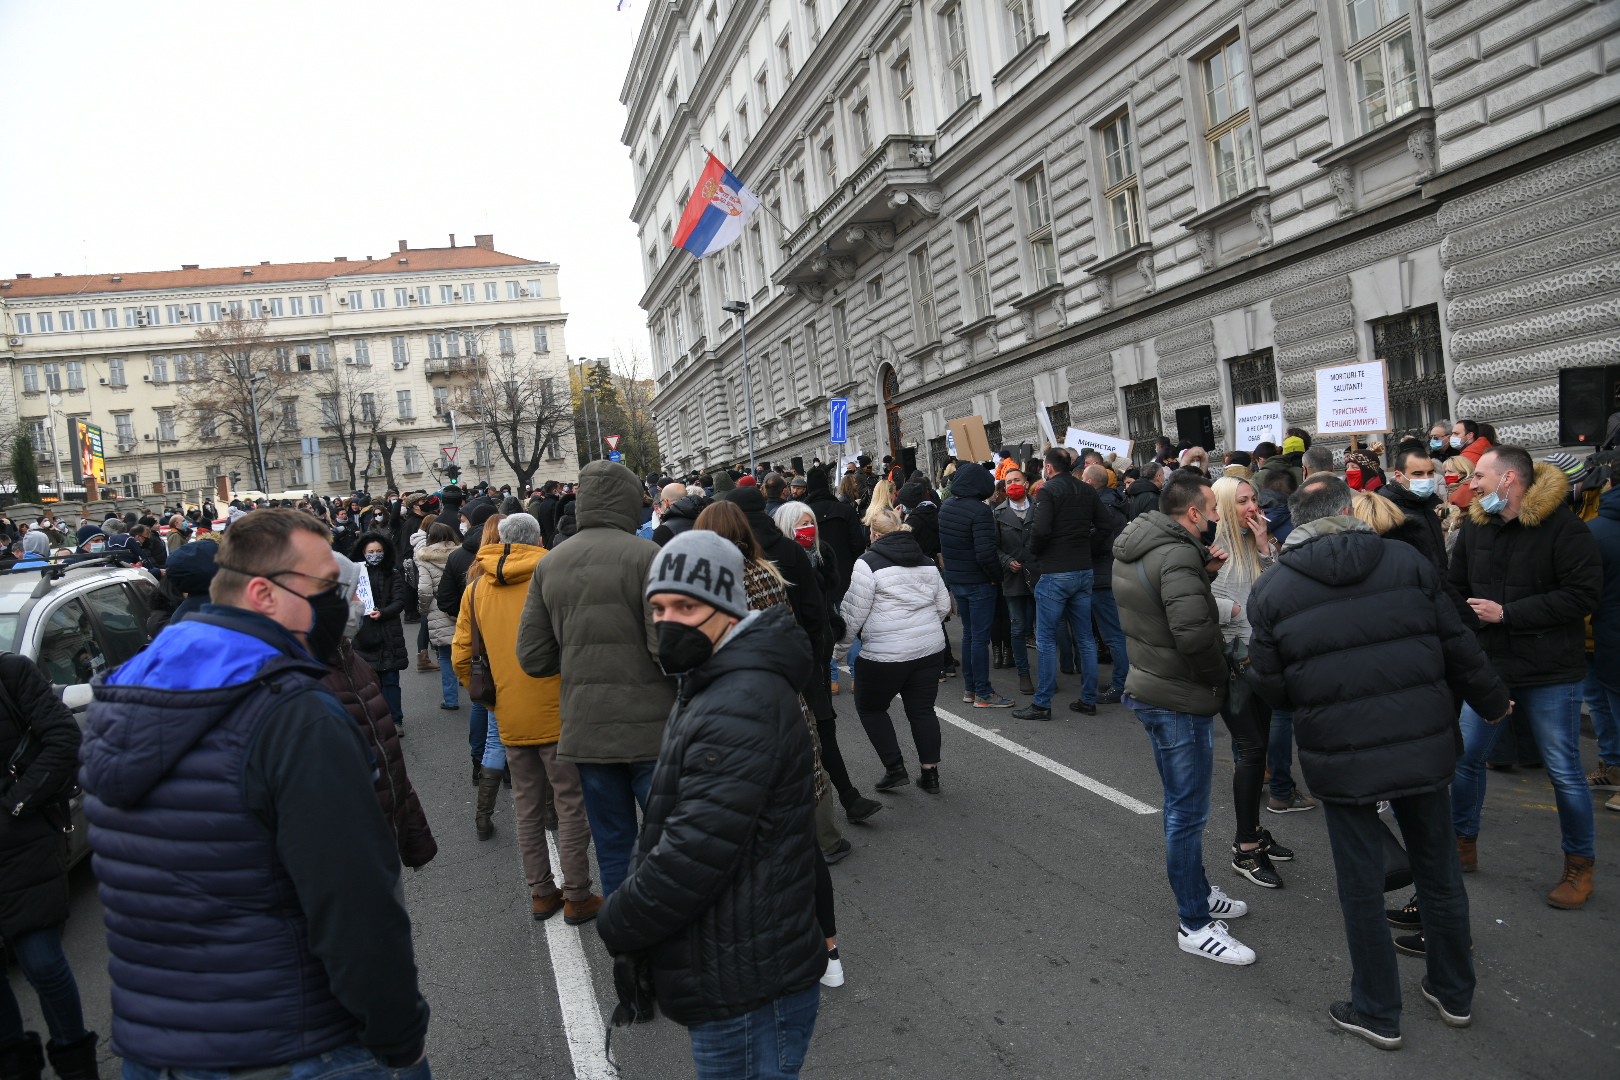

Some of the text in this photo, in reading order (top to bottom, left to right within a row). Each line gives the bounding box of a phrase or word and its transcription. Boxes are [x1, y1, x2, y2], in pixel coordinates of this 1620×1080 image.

[1357, 370, 1365, 378] TE
[1077, 438, 1116, 452] МИНИСТАР
[649, 552, 735, 603] MAR
